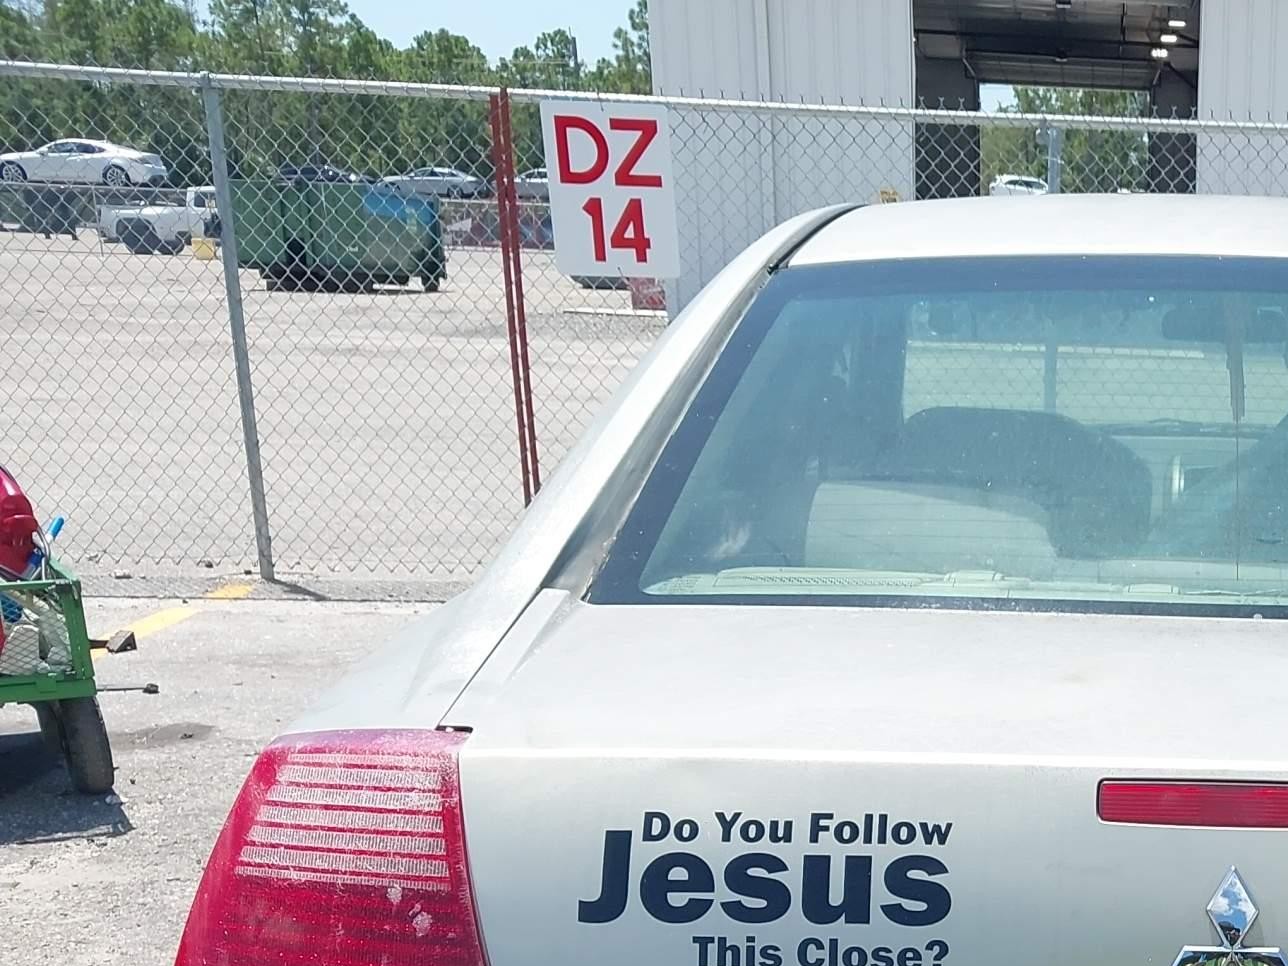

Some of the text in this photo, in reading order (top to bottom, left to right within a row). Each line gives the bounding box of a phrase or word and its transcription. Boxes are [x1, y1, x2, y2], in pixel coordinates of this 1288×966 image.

[554, 115, 662, 188] DZ
[582, 197, 651, 263] 14
[642, 812, 953, 844] Do You Follow
[578, 829, 952, 927] Jesus
